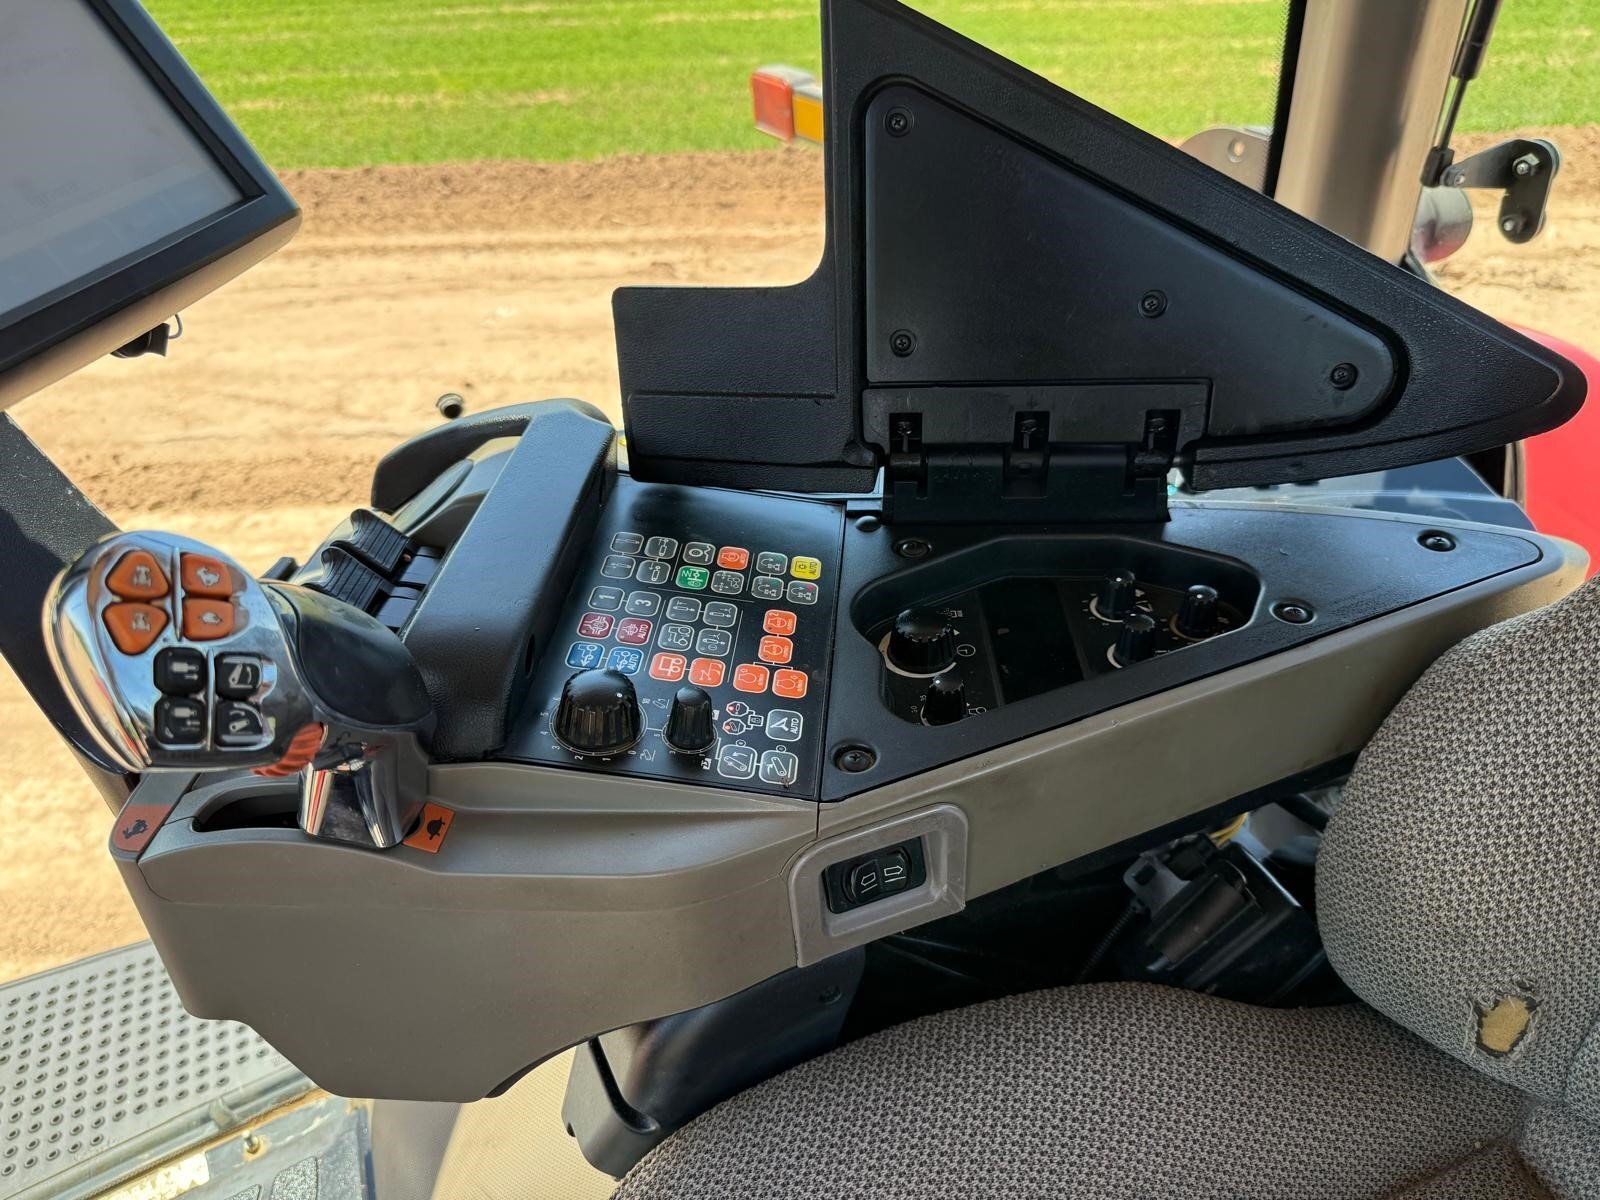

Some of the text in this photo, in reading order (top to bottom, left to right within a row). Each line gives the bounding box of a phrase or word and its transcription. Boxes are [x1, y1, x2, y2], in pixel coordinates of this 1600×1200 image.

[809, 561, 818, 575] AUTO
[635, 599, 652, 607] 3
[638, 624, 649, 640] AUTO
[627, 653, 639, 671] AUTO
[790, 717, 800, 734] AUTO
